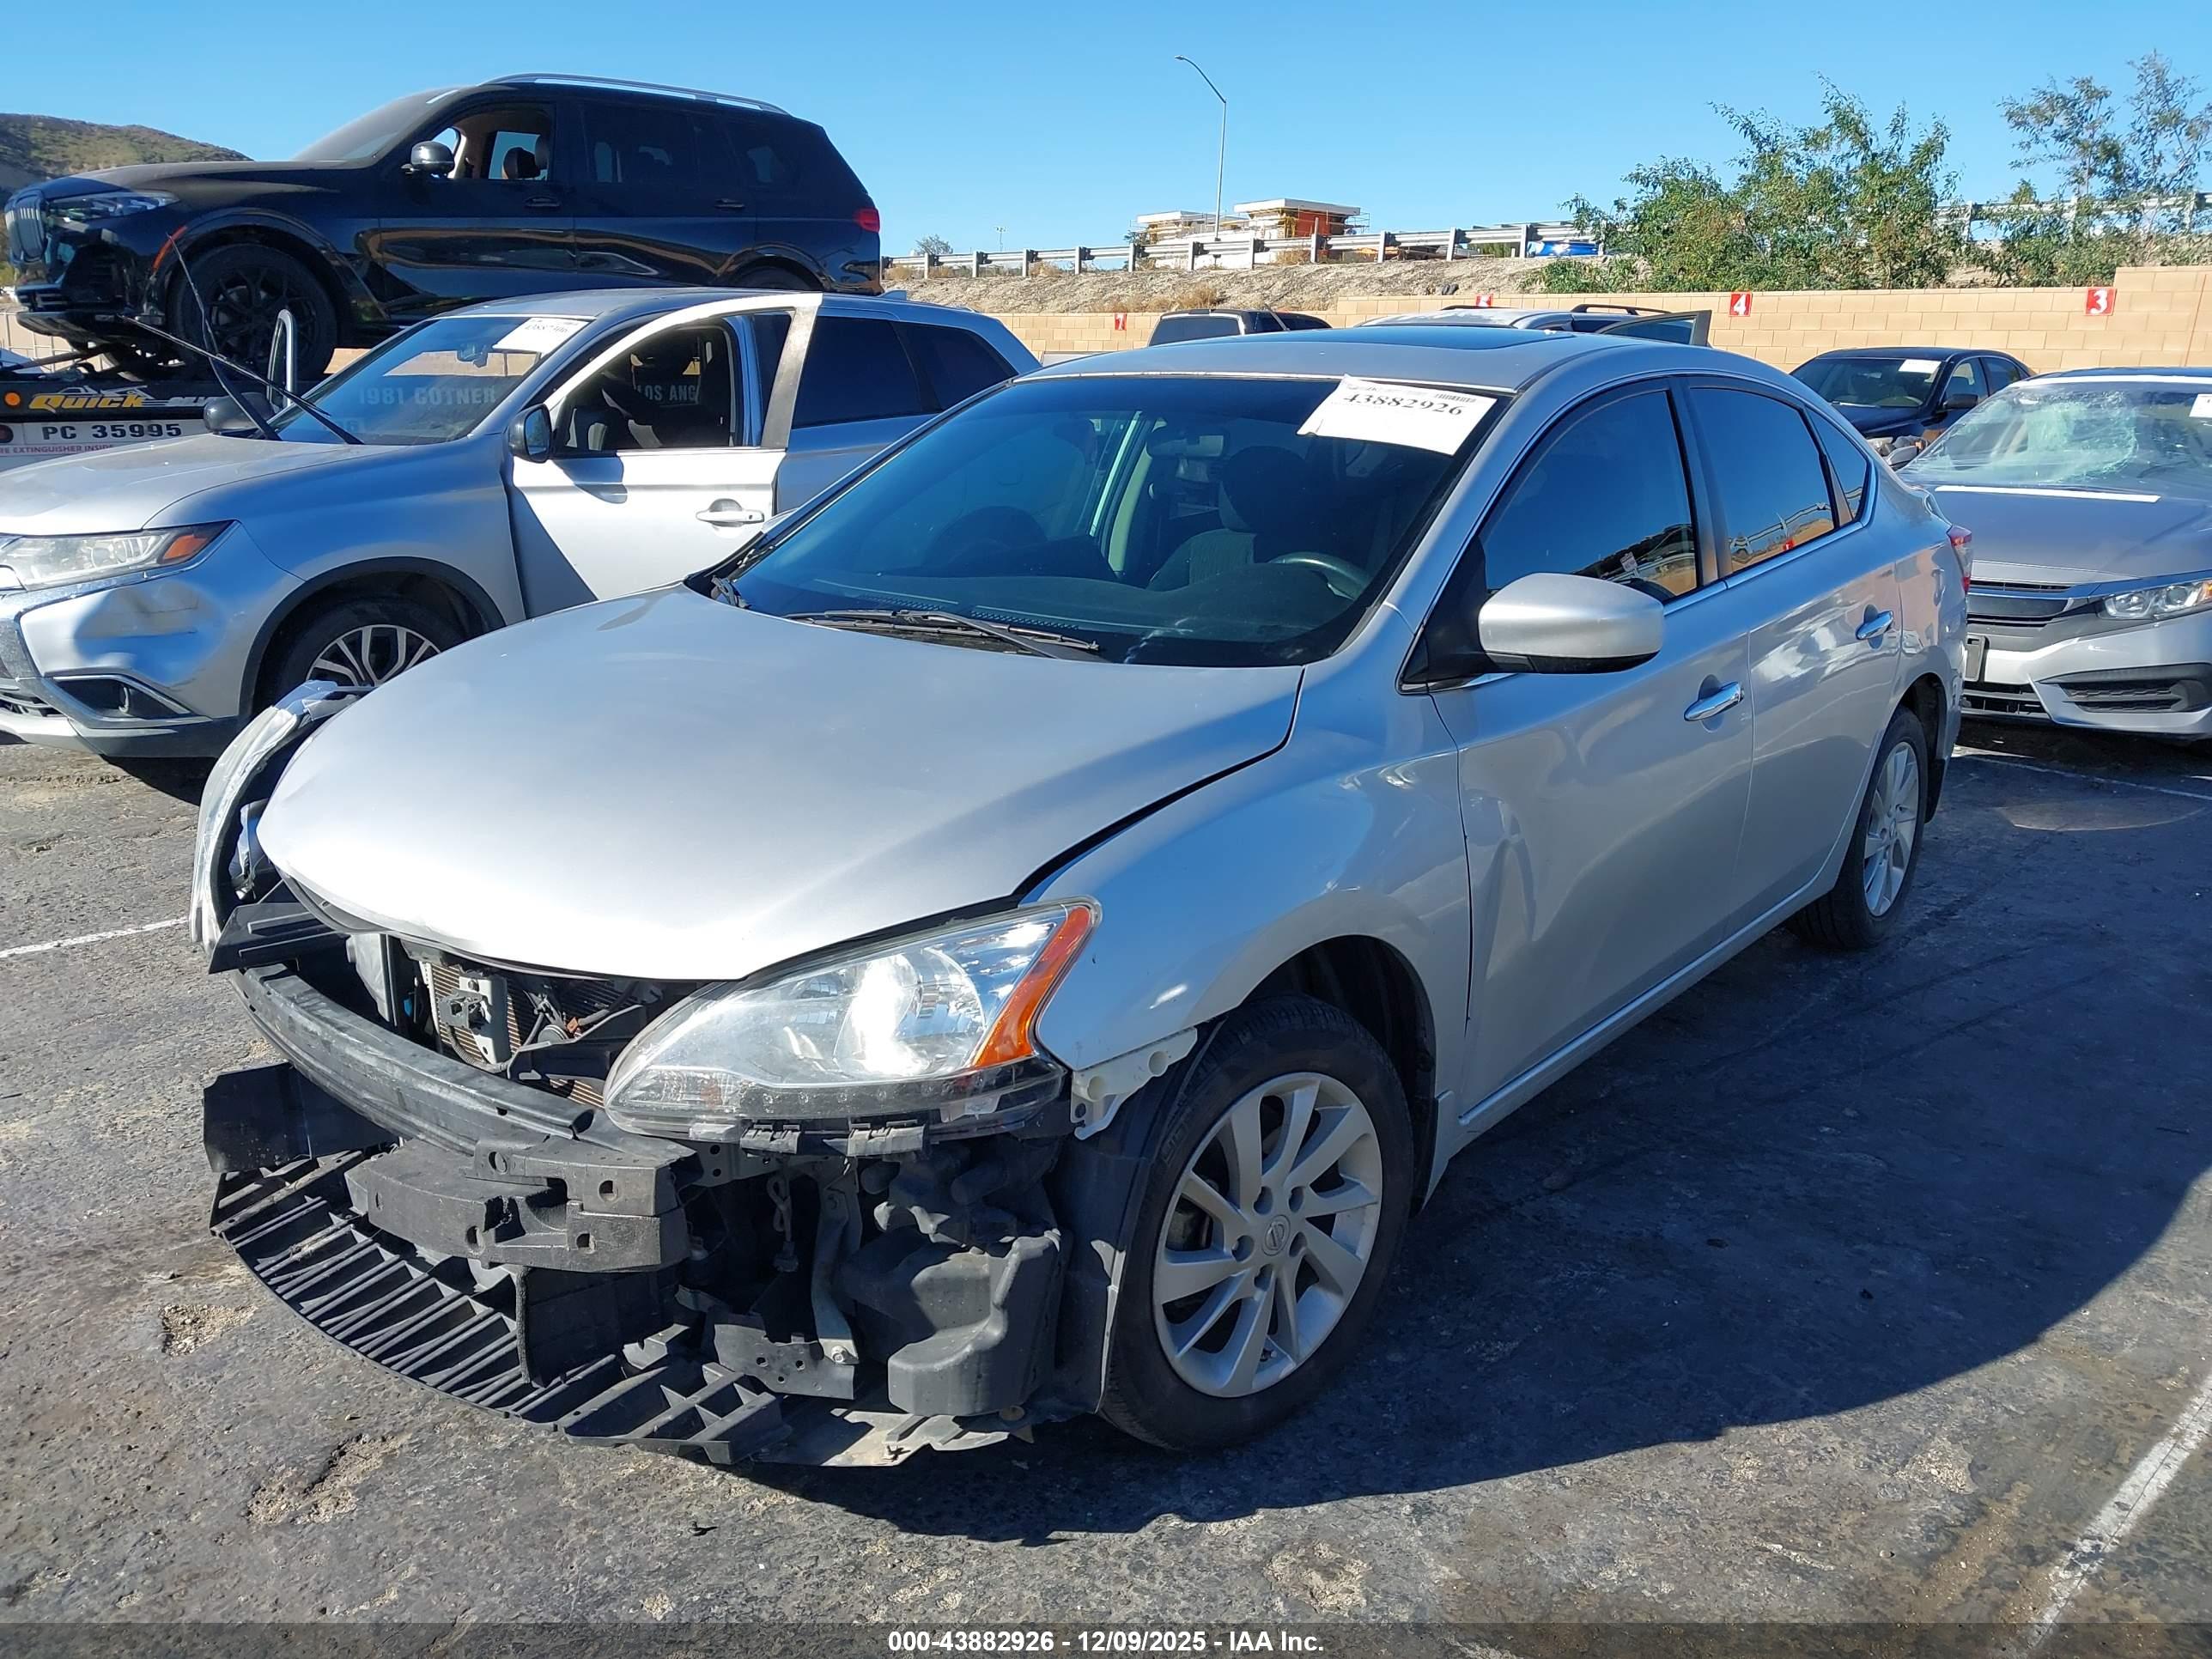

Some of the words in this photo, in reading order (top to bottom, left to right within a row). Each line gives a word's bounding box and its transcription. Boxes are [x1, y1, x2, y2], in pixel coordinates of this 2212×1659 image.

[1733, 294, 1747, 315] 4
[2089, 288, 2108, 314] 3
[359, 386, 404, 405] 1981
[1344, 393, 1466, 416] 43882926
[41, 425, 77, 440] PC
[91, 423, 182, 439] 35995
[13, 445, 82, 454] EXTINGUISHER
